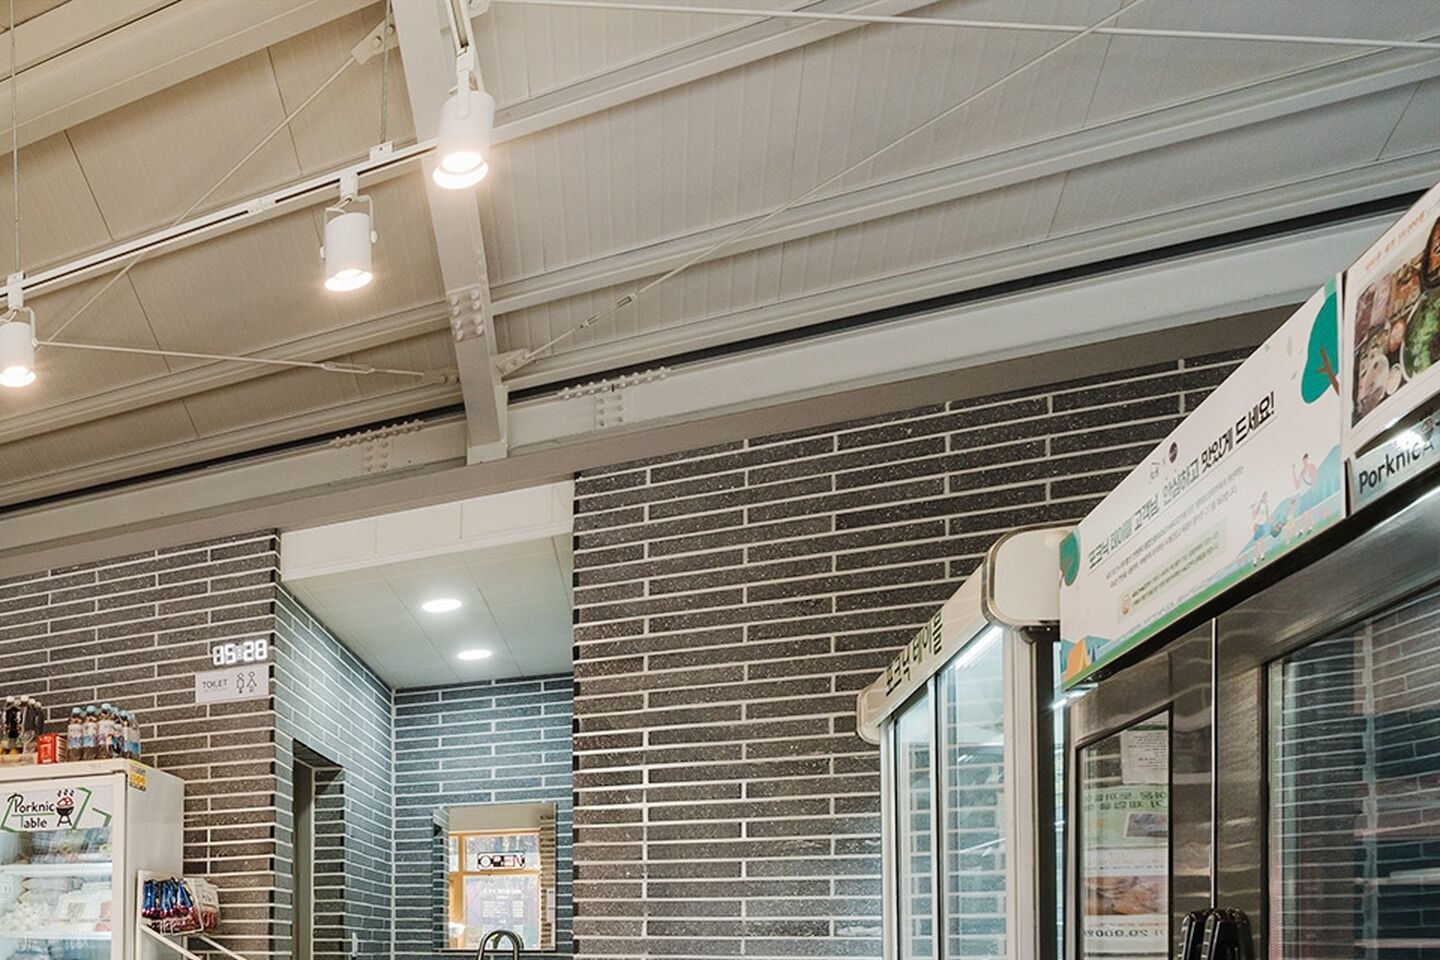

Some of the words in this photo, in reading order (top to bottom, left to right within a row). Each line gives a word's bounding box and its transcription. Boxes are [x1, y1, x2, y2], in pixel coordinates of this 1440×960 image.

[1200, 427, 1233, 474] 맛있게
[1235, 390, 1274, 444] 드세요!
[8, 793, 56, 814] Porknic
[478, 854, 525, 869] OPEN
